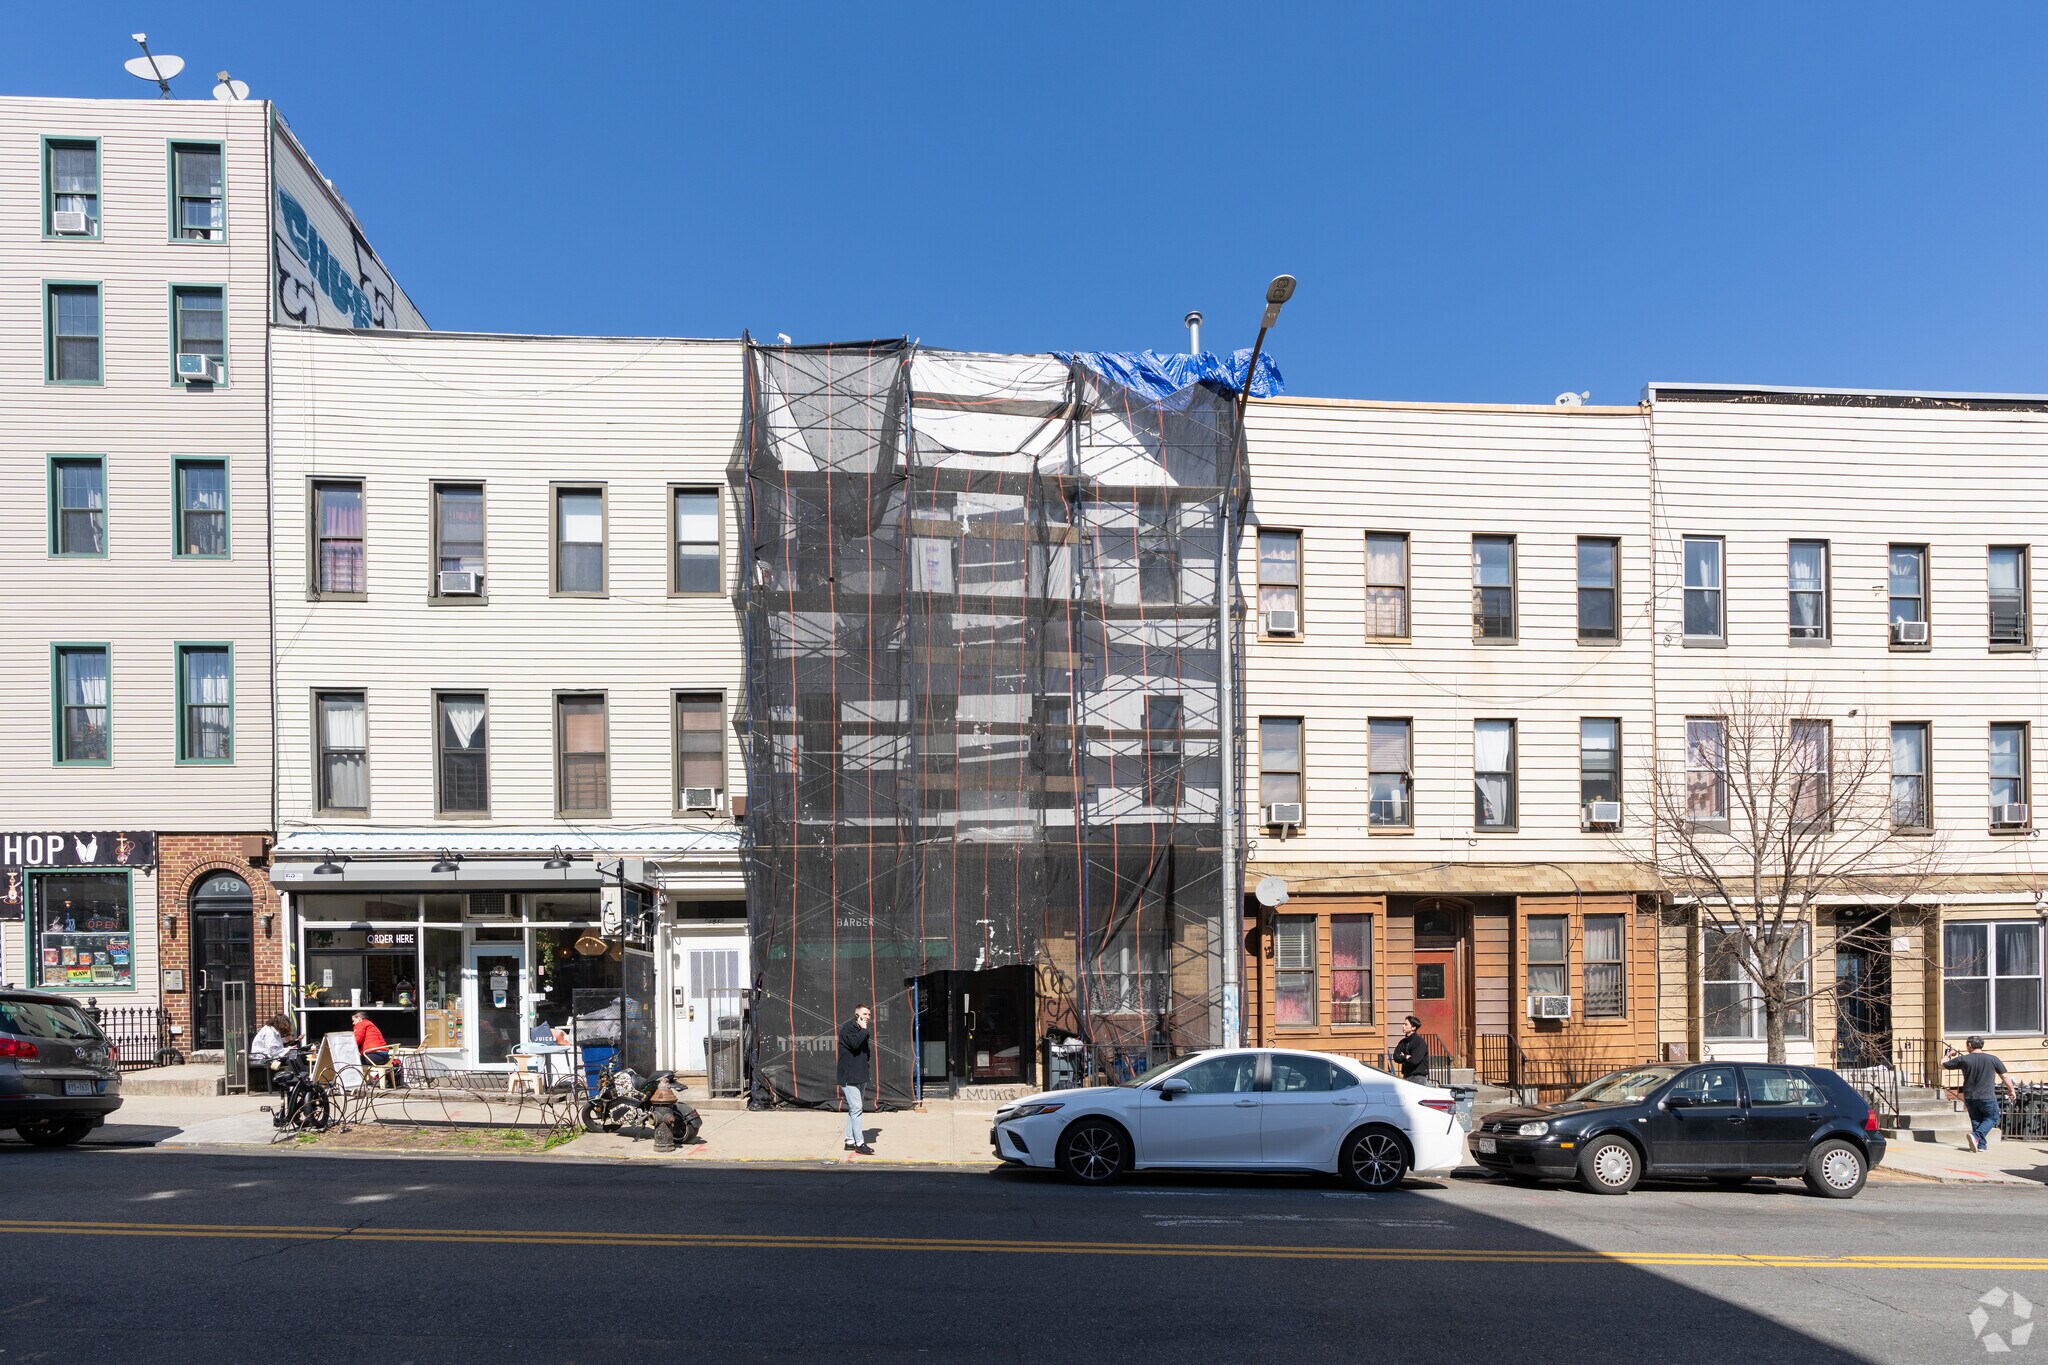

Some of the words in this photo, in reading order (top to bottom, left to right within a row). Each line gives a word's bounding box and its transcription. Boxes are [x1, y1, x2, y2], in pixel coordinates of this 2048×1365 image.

[4, 835, 65, 865] HOP
[212, 881, 240, 892] 149
[88, 920, 119, 929] OPEN
[836, 917, 875, 927] BARBER
[367, 934, 394, 944] ORDER
[395, 934, 414, 944] HERE
